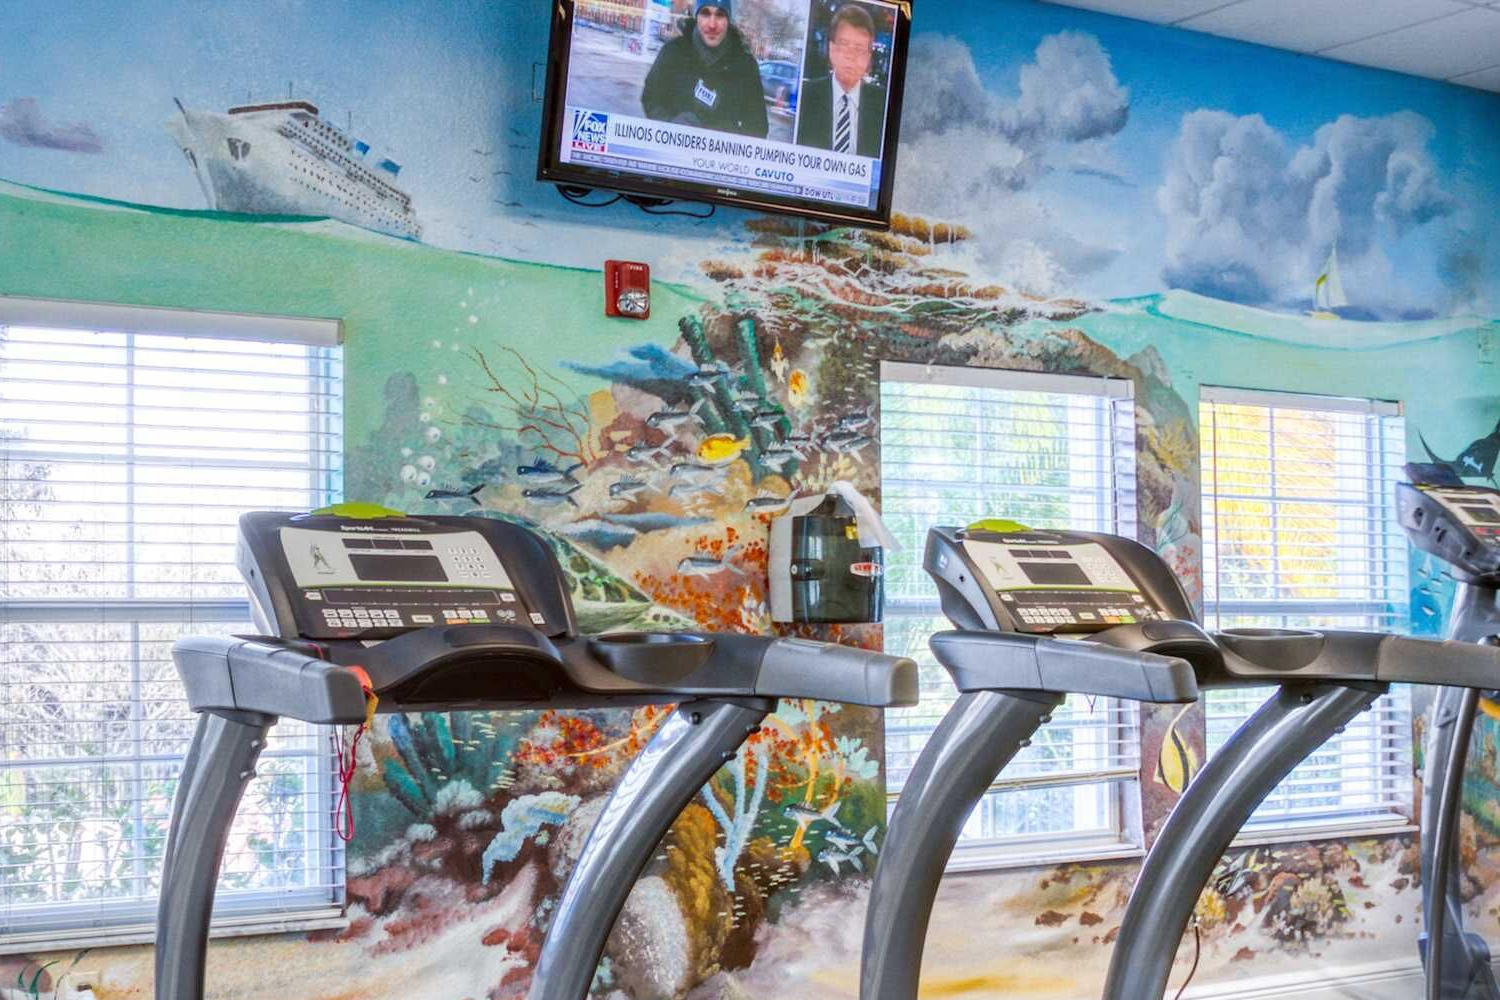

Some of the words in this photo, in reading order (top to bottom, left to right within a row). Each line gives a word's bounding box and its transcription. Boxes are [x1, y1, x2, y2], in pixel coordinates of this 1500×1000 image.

[584, 119, 606, 132] FOX
[577, 131, 606, 145] NEWS
[614, 122, 653, 142] ILLINOIS
[655, 129, 707, 151] CONSIDERS
[708, 138, 753, 159] BANNING
[754, 146, 796, 166] PUMPING
[797, 153, 821, 170] YOUR
[823, 158, 846, 174] OWN
[848, 162, 867, 178] GAS
[692, 157, 716, 169] YOUR
[718, 161, 750, 175] WORLD
[754, 167, 795, 182] CAVUTO
